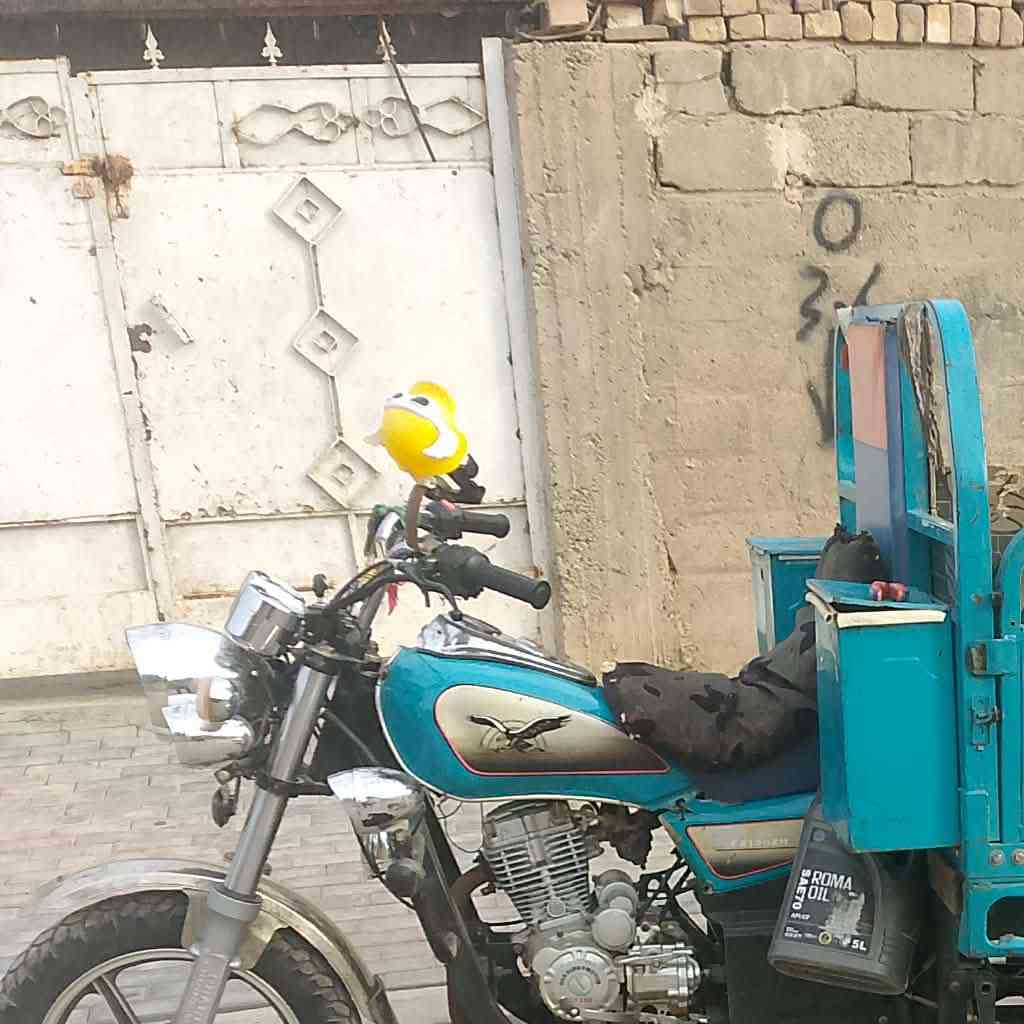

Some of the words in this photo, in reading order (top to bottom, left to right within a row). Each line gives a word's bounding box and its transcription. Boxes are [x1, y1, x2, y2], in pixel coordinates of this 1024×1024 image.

[811, 870, 853, 890] ROMA
[807, 885, 830, 902] OIL
[851, 939, 867, 952] 5L
